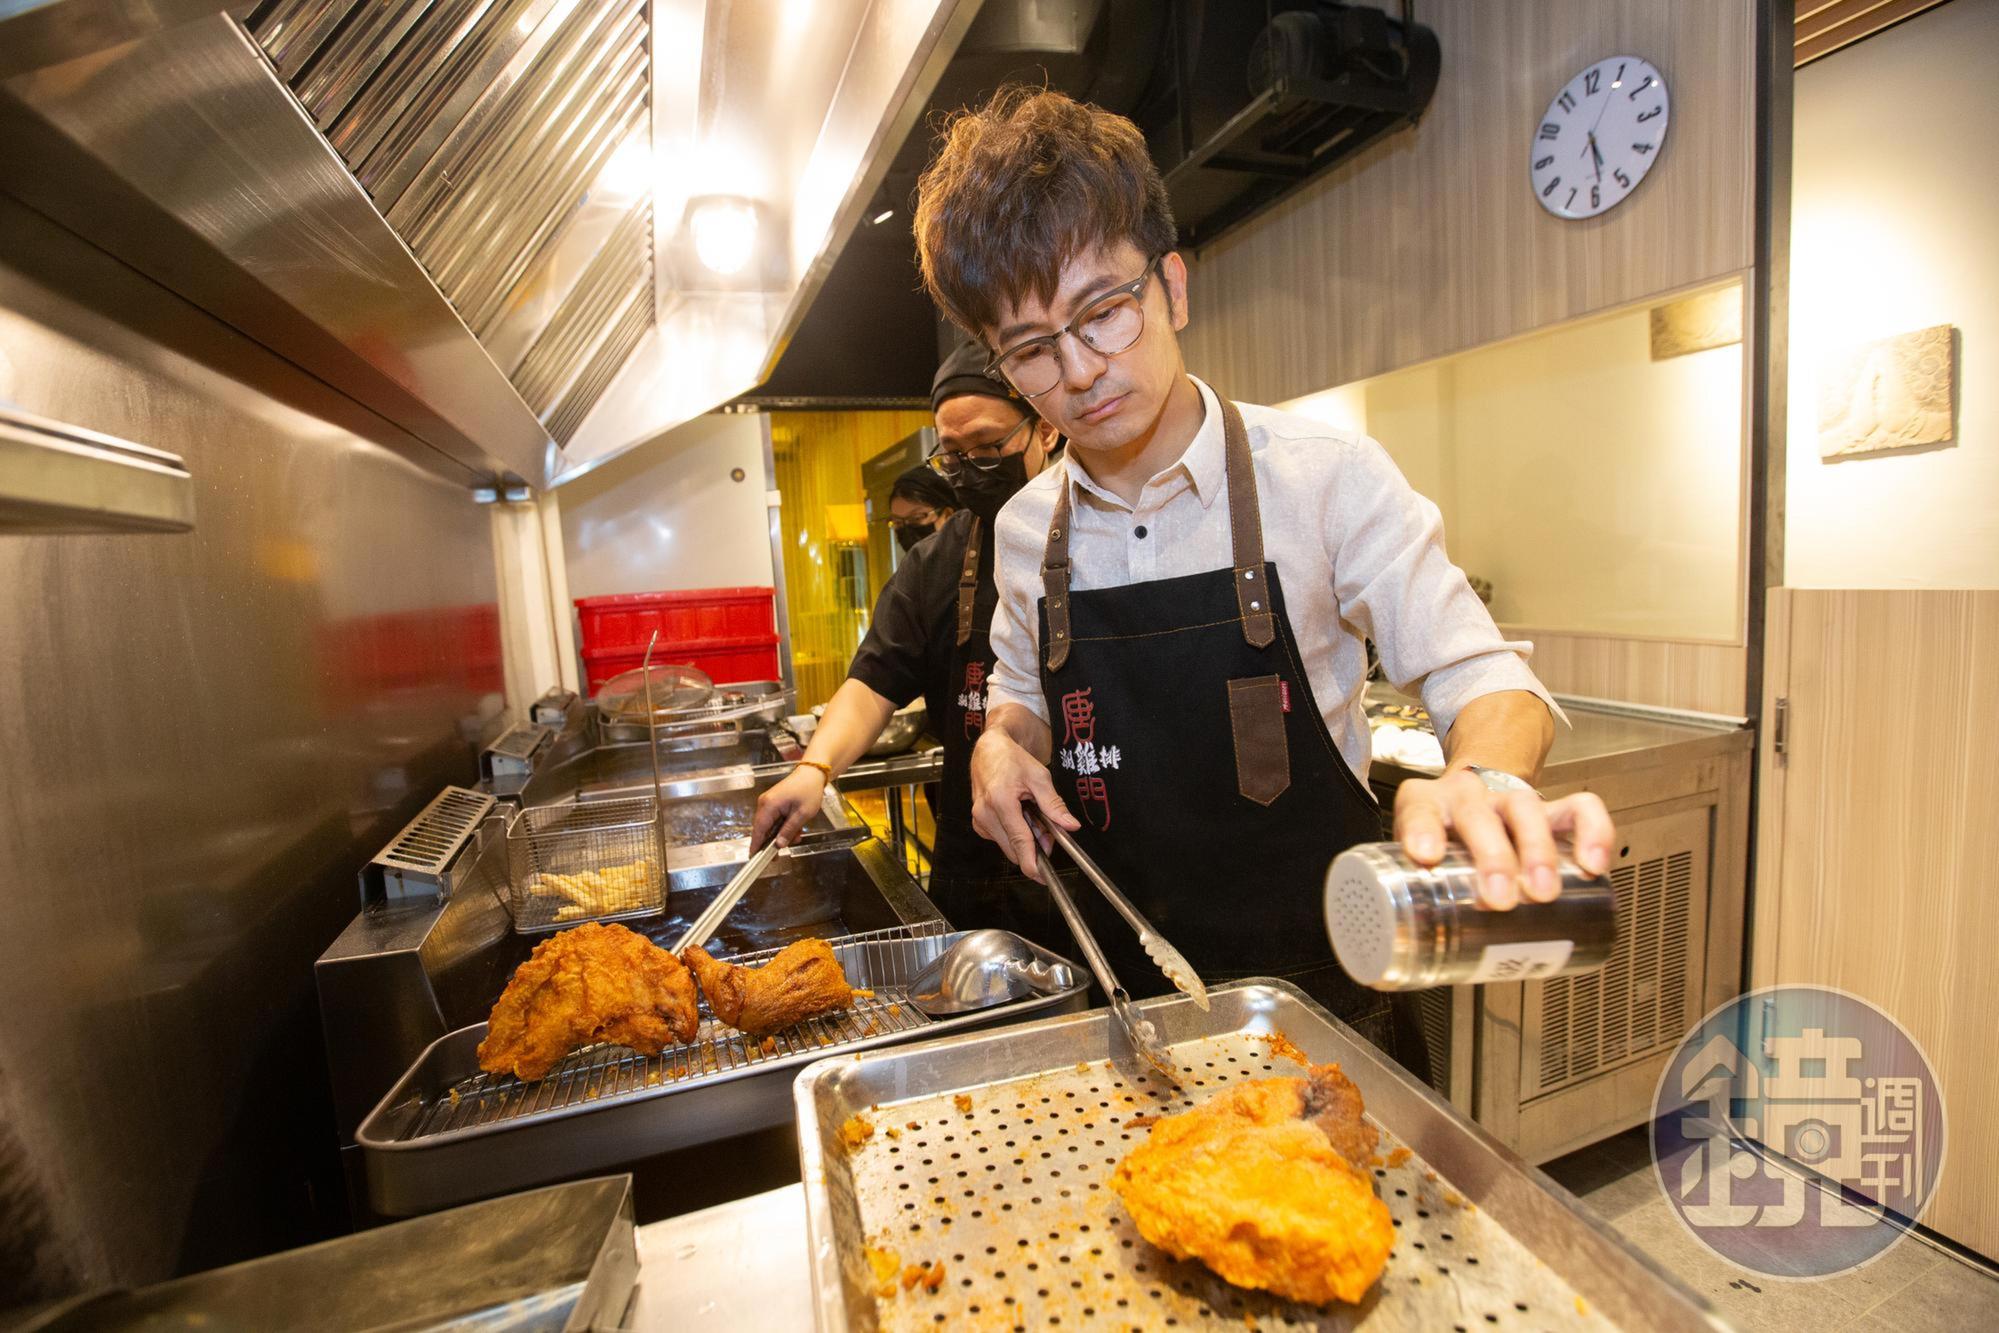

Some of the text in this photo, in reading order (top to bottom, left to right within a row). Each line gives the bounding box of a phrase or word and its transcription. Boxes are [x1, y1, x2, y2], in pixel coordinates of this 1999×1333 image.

[1584, 69, 1600, 97] 12
[1616, 62, 1626, 84] 1
[1629, 75, 1652, 101] 2
[1558, 90, 1577, 114] 11
[1637, 105, 1662, 123] 3
[1539, 123, 1560, 141] 10
[1631, 142, 1654, 155] 4
[1534, 155, 1555, 170] 9
[1543, 176, 1561, 197] 8
[1613, 168, 1630, 189] 5
[1564, 188, 1578, 210] 7
[1591, 185, 1600, 208] 6
